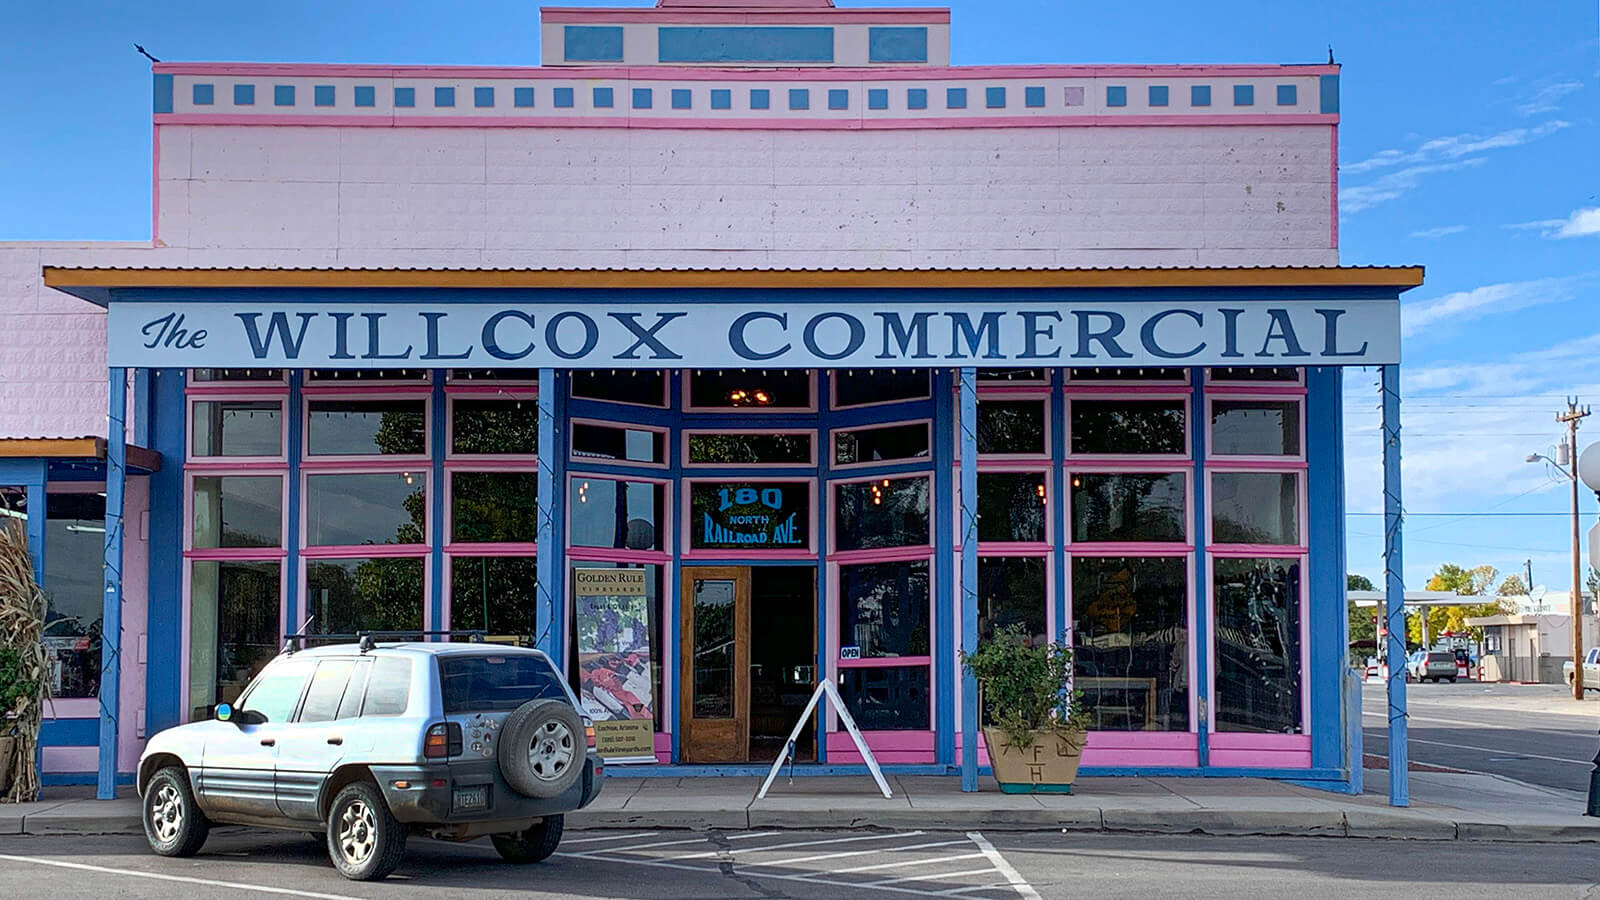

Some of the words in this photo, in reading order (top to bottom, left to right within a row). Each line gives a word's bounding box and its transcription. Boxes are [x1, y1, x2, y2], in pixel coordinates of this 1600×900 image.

[142, 311, 208, 349] The
[233, 310, 688, 360] WILLCOX
[728, 309, 1369, 361] COMMERCIAL
[718, 487, 783, 512] 180
[704, 512, 768, 544] RAILROAD
[772, 512, 802, 544] AVE.
[729, 515, 770, 525] NORTH
[577, 572, 618, 583] GOLDEN
[619, 572, 644, 583] RULE
[842, 648, 859, 658] OPEN
